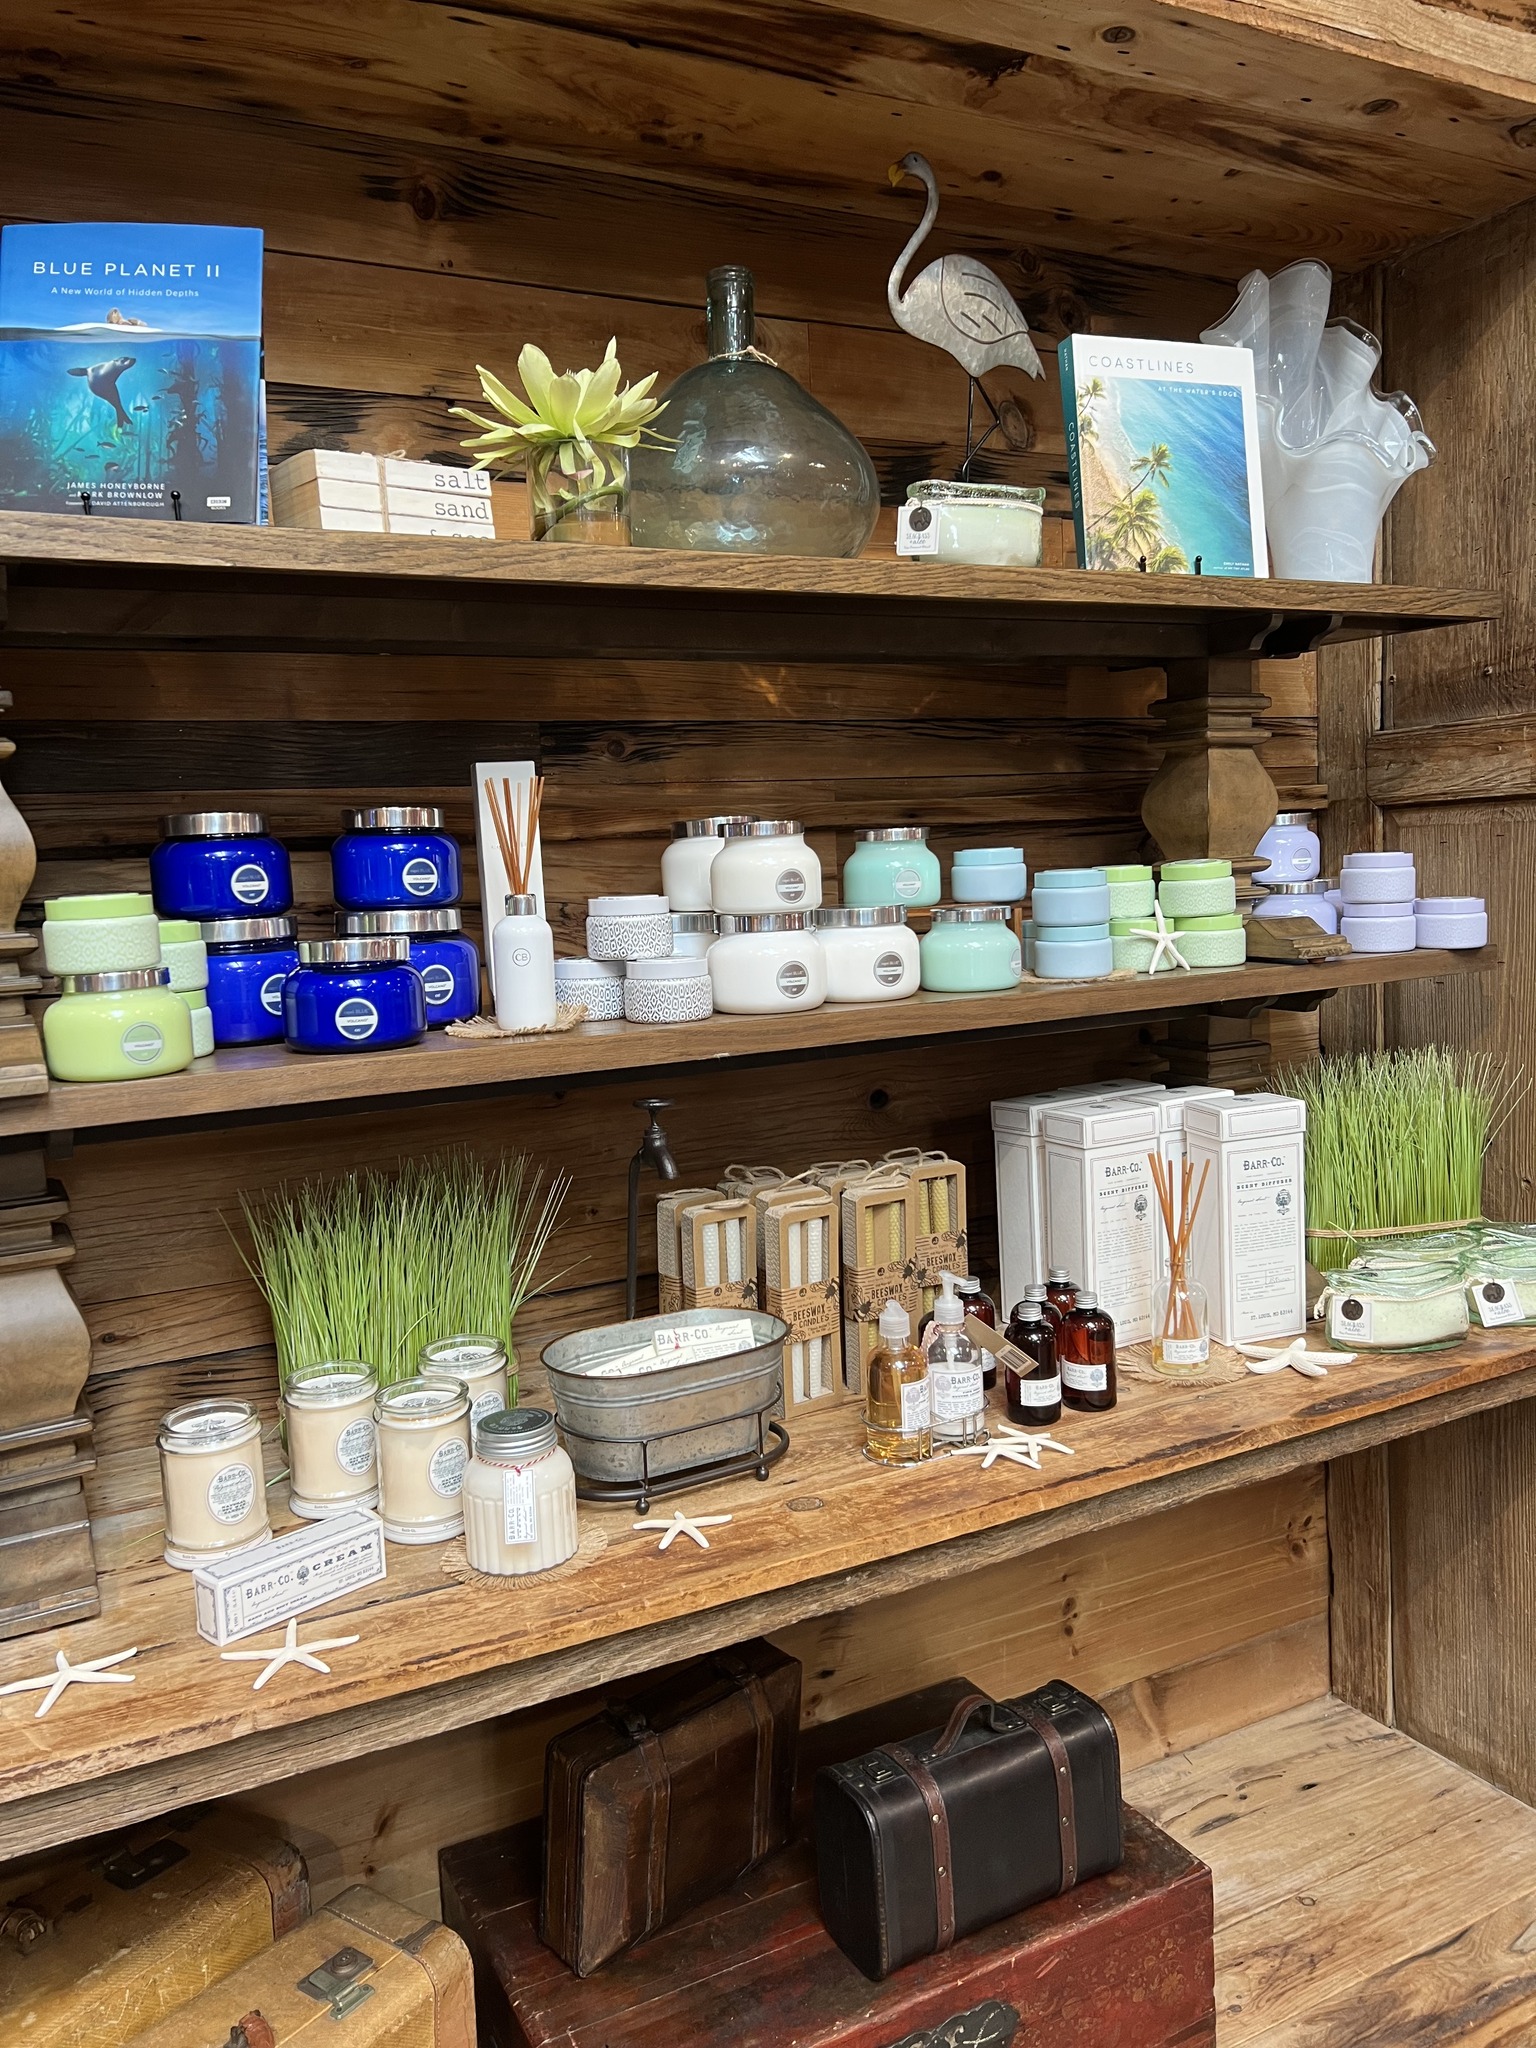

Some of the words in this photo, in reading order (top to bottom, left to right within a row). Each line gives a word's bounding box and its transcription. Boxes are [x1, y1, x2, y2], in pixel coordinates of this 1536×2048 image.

[33, 261, 93, 275] BLUE
[104, 263, 197, 278] PLANET
[206, 264, 220, 278] II
[61, 287, 81, 295] New
[84, 288, 113, 296] World
[115, 288, 125, 296] of
[128, 289, 163, 297] Hidden
[165, 289, 199, 298] Depths
[1088, 355, 1195, 375] COASTLINES
[1186, 388, 1216, 397] WATER'S
[1218, 390, 1238, 398] EDGE
[1068, 422, 1081, 509] COASTLINES
[66, 482, 97, 490] JAMES
[100, 482, 166, 490] HONEYBORNE
[434, 470, 488, 491] salt
[107, 491, 163, 499] BROWNLOW
[434, 502, 490, 520] sand
[514, 953, 529, 962] CB
[926, 1252, 957, 1267] BEESWAX
[871, 1283, 903, 1300] BEESWAX
[792, 1303, 826, 1322] BEESWAX
[798, 1313, 830, 1329] CANDLES
[311, 1542, 373, 1571] CREAM
[245, 1574, 294, 1600] BARR-CO.
